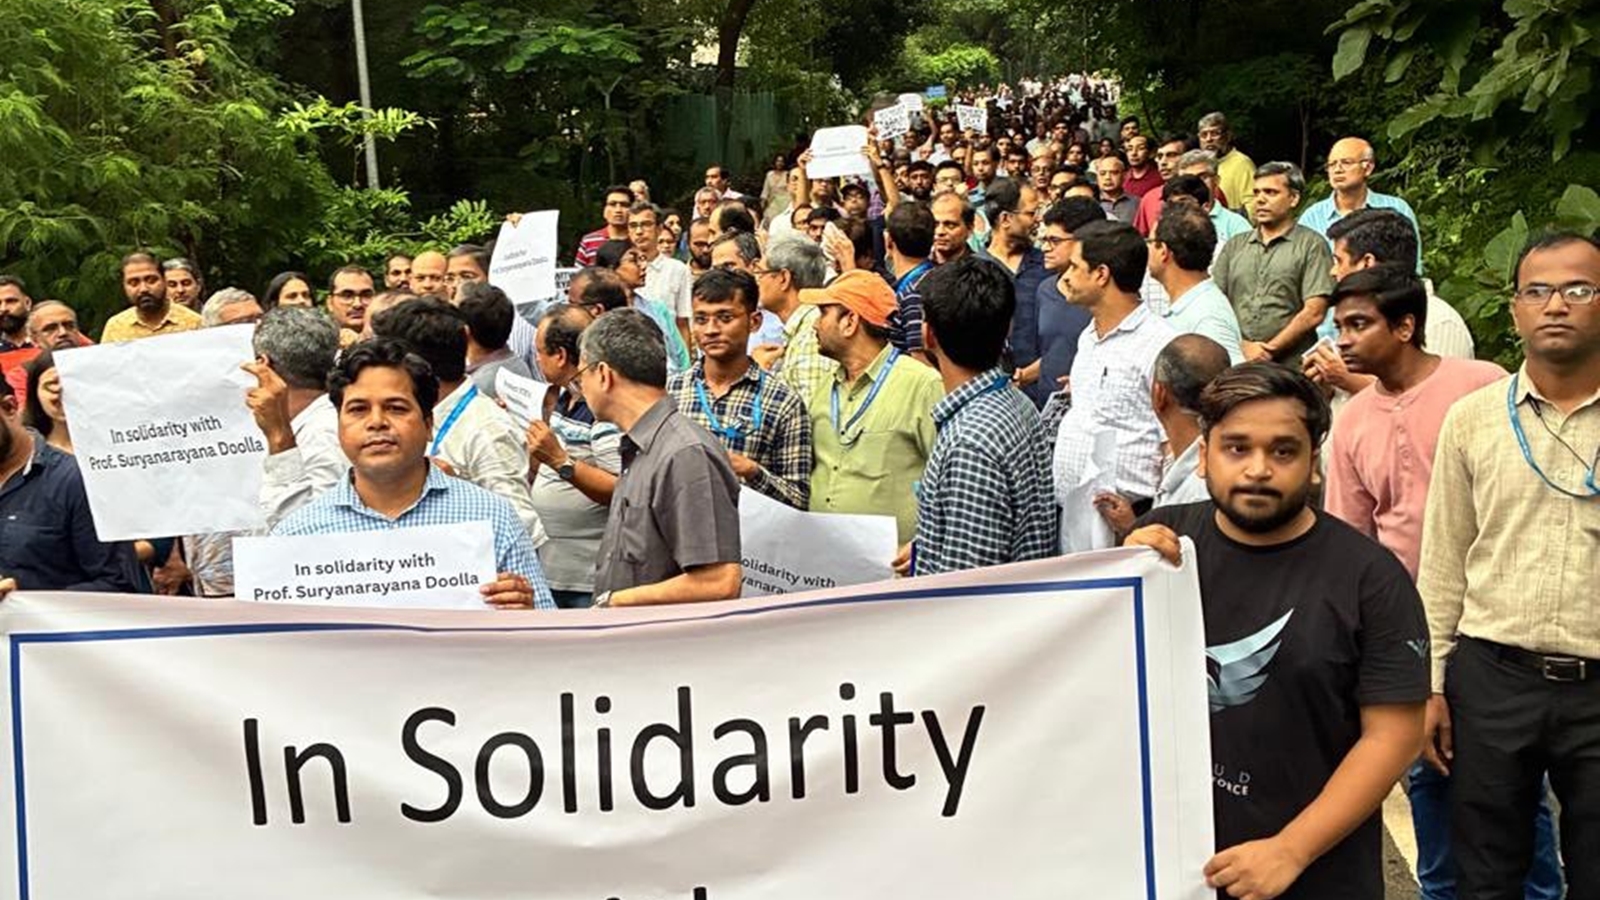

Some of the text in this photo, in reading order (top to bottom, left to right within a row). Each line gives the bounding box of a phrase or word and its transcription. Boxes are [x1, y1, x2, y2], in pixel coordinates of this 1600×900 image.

[110, 415, 222, 444] In solidarity with
[89, 436, 264, 470] Prof. Suryanarayana Doolla
[295, 552, 435, 576] In solidarity with
[741, 557, 837, 588] olidarity with
[253, 572, 479, 601] Prof. Suryanarayana Doolla
[242, 682, 985, 825] In Solidarity
